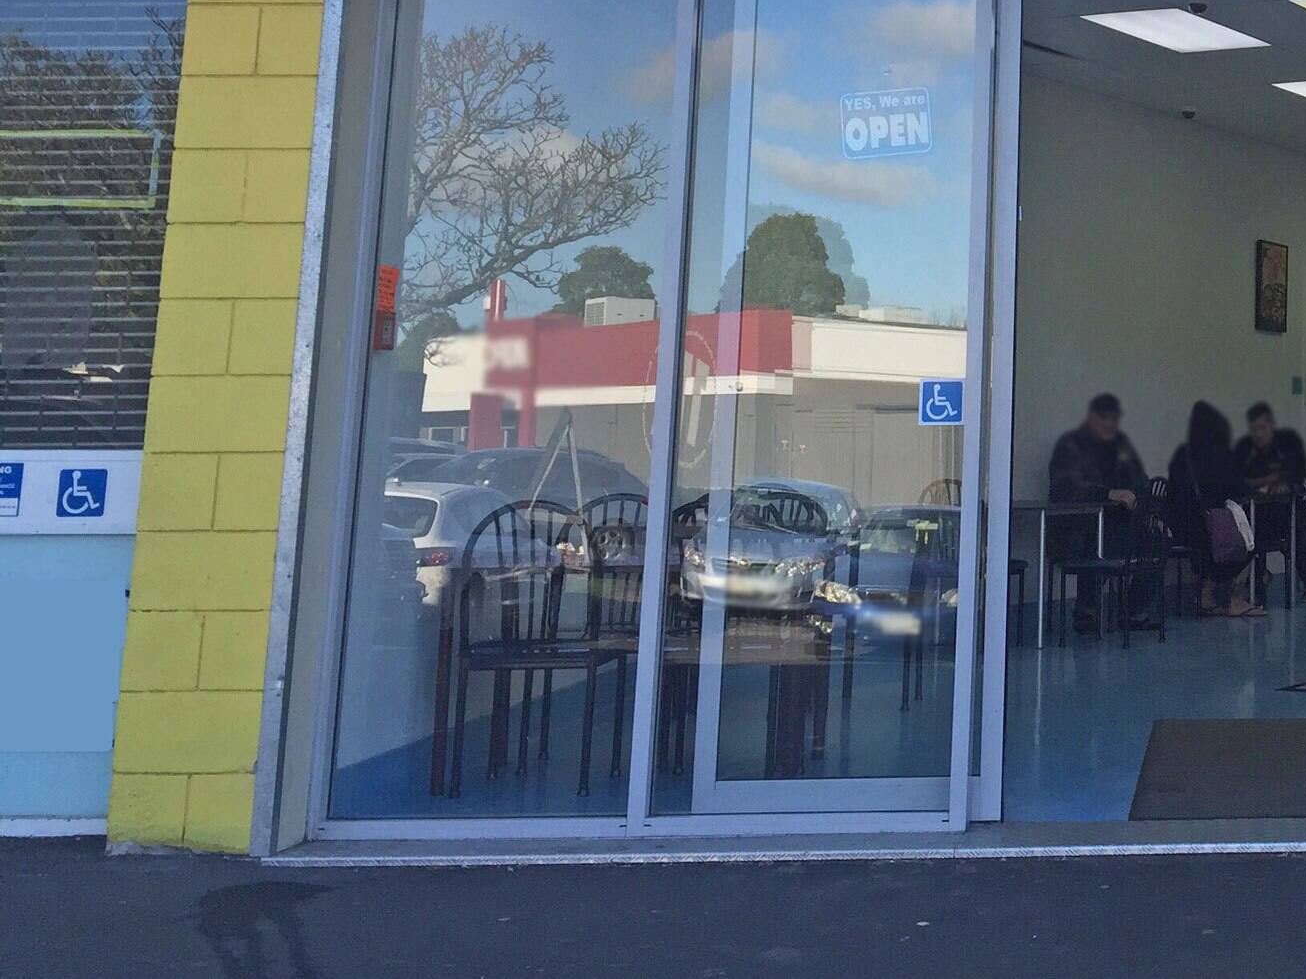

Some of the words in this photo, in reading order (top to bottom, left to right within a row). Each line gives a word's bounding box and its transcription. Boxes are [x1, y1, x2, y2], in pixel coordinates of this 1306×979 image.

[845, 97, 876, 111] YES,
[880, 95, 899, 108] We
[904, 95, 925, 106] are
[845, 111, 929, 151] OPEN
